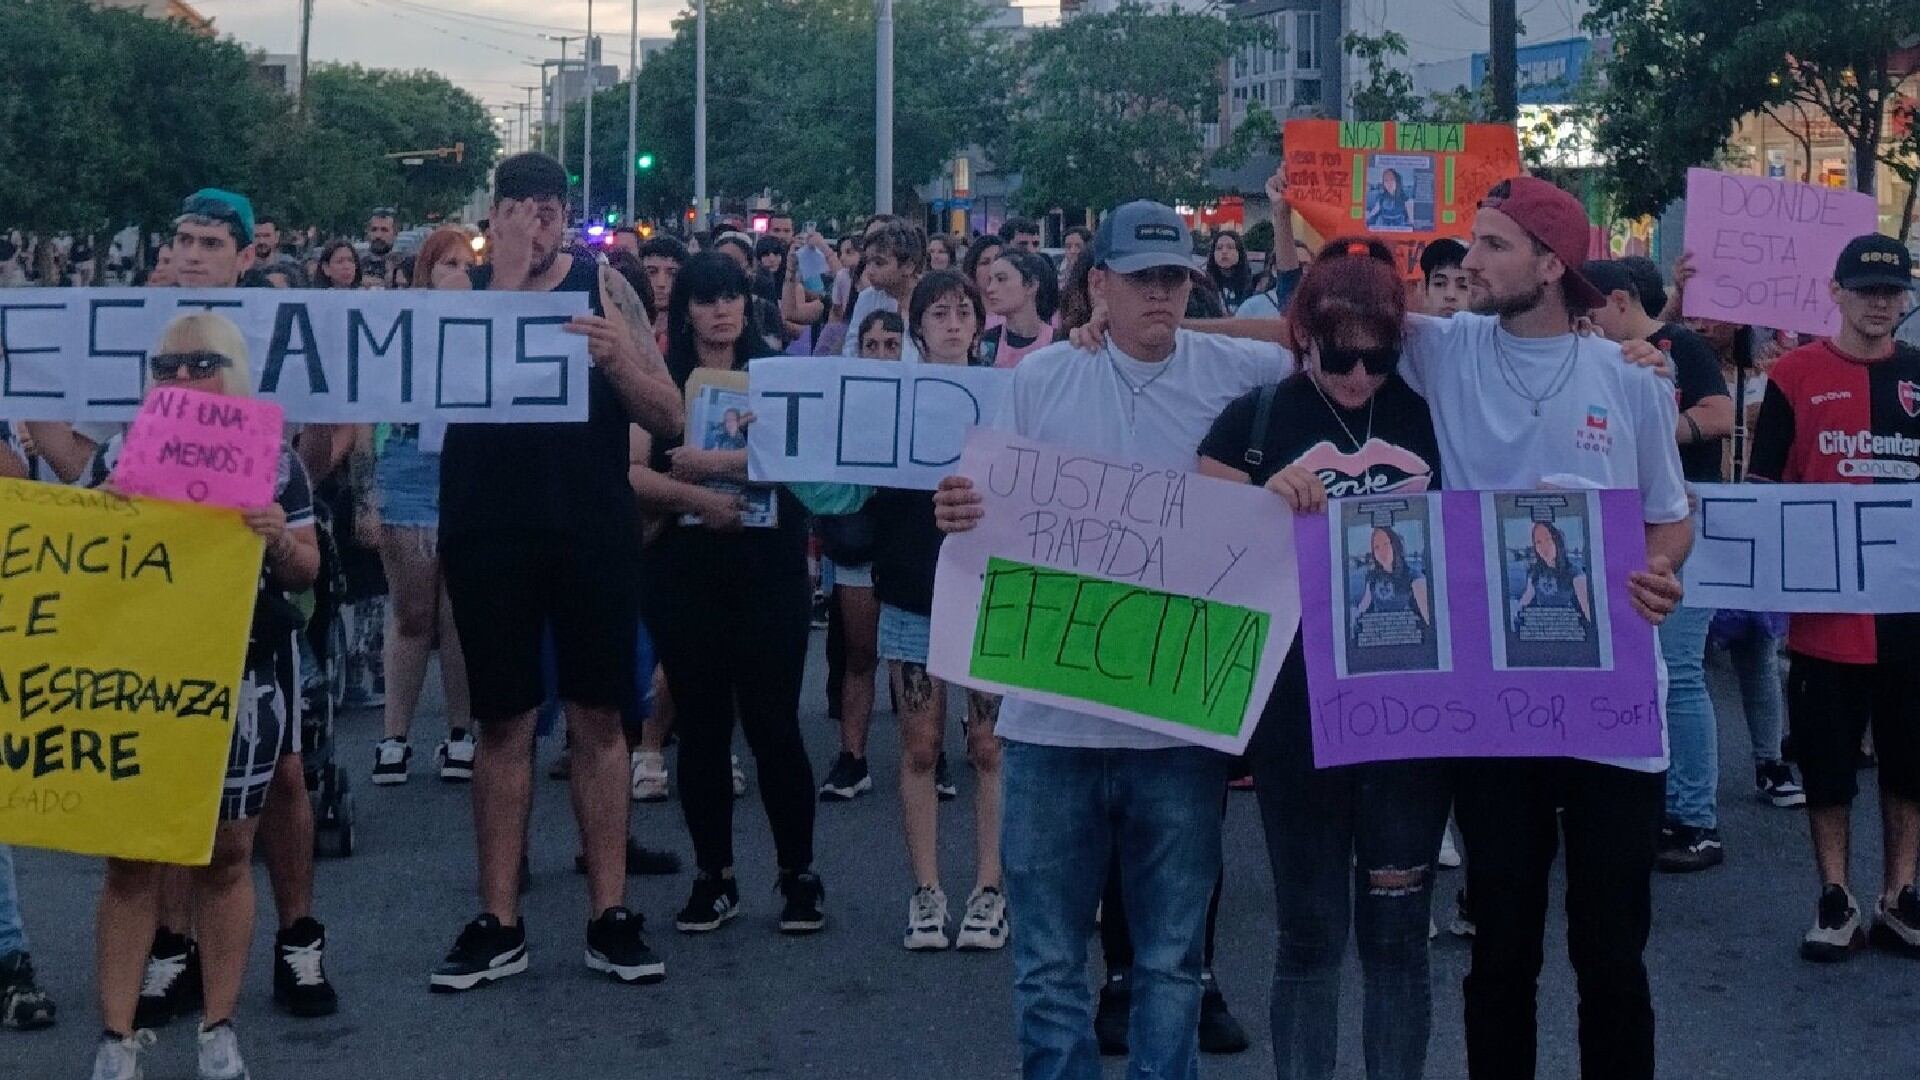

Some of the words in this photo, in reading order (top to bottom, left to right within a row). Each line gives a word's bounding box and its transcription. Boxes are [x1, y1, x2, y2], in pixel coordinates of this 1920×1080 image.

[1343, 120, 1381, 149] NOS
[1399, 120, 1460, 153] FALTA
[1717, 175, 1845, 226] DONDE
[1712, 229, 1797, 267] ESTA
[1, 299, 574, 409] ESAMOS
[1818, 429, 1920, 458] CityCenter
[988, 445, 1187, 529] JUSTICIA
[1019, 510, 1165, 587] RAPIDA
[1206, 544, 1249, 595] Y
[1698, 497, 1913, 592] SOF
[979, 566, 1260, 730] EFECTIVA
[20, 662, 231, 722] ESPERANZA
[1497, 687, 1566, 741] POR
[0, 725, 140, 781] UERE
